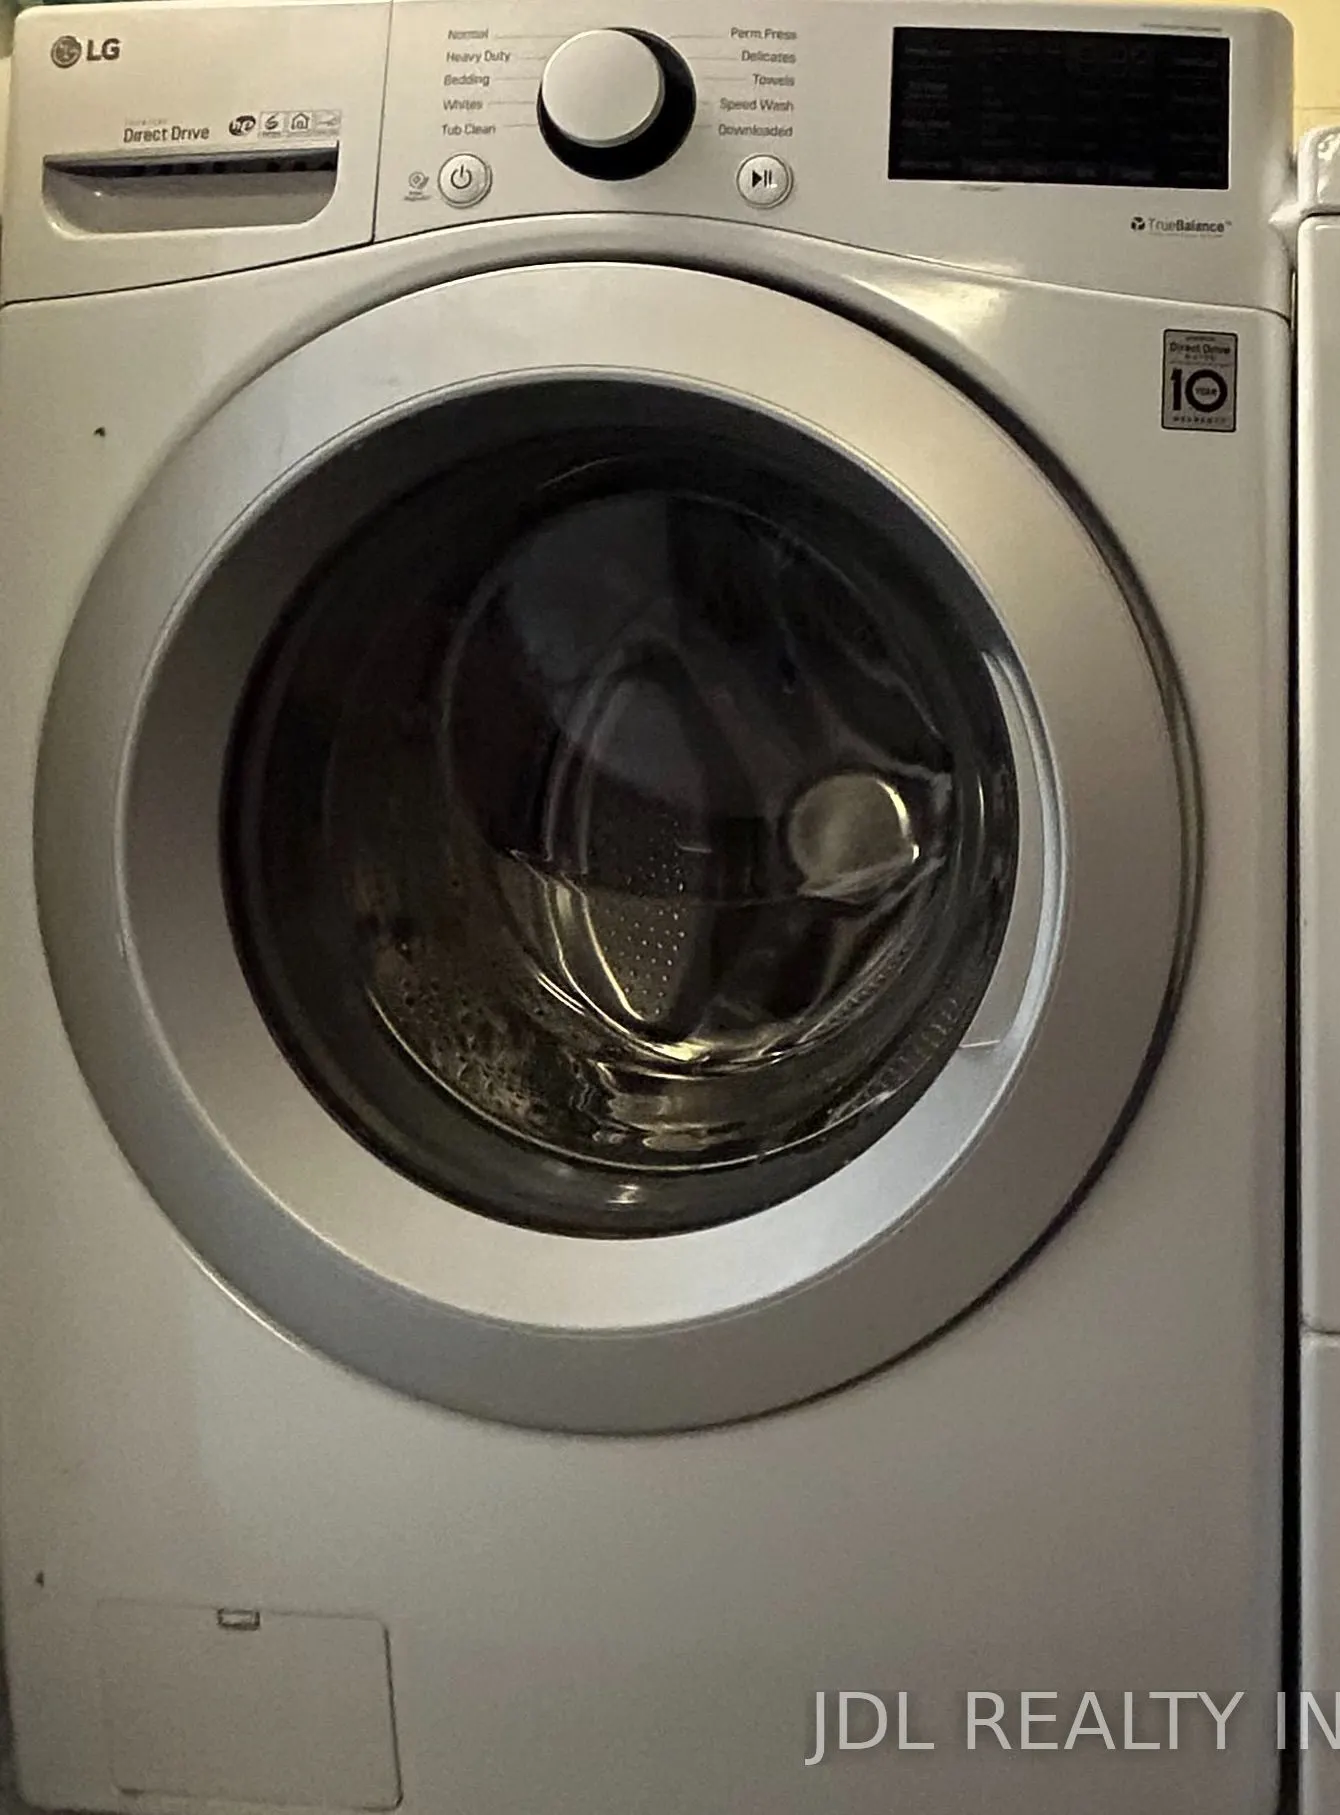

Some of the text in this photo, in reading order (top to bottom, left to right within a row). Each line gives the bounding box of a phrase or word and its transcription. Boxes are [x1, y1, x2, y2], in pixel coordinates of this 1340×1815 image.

[86, 38, 121, 61] LG
[446, 50, 510, 63] Heavy Duty
[741, 50, 796, 64] Delicates
[443, 74, 490, 87] Bedding
[720, 97, 794, 112] Speed Wash
[123, 125, 209, 143] Direct Drive
[442, 123, 496, 136] Tub Clean
[718, 124, 793, 137] Downloaded
[1170, 367, 1228, 413] 10
